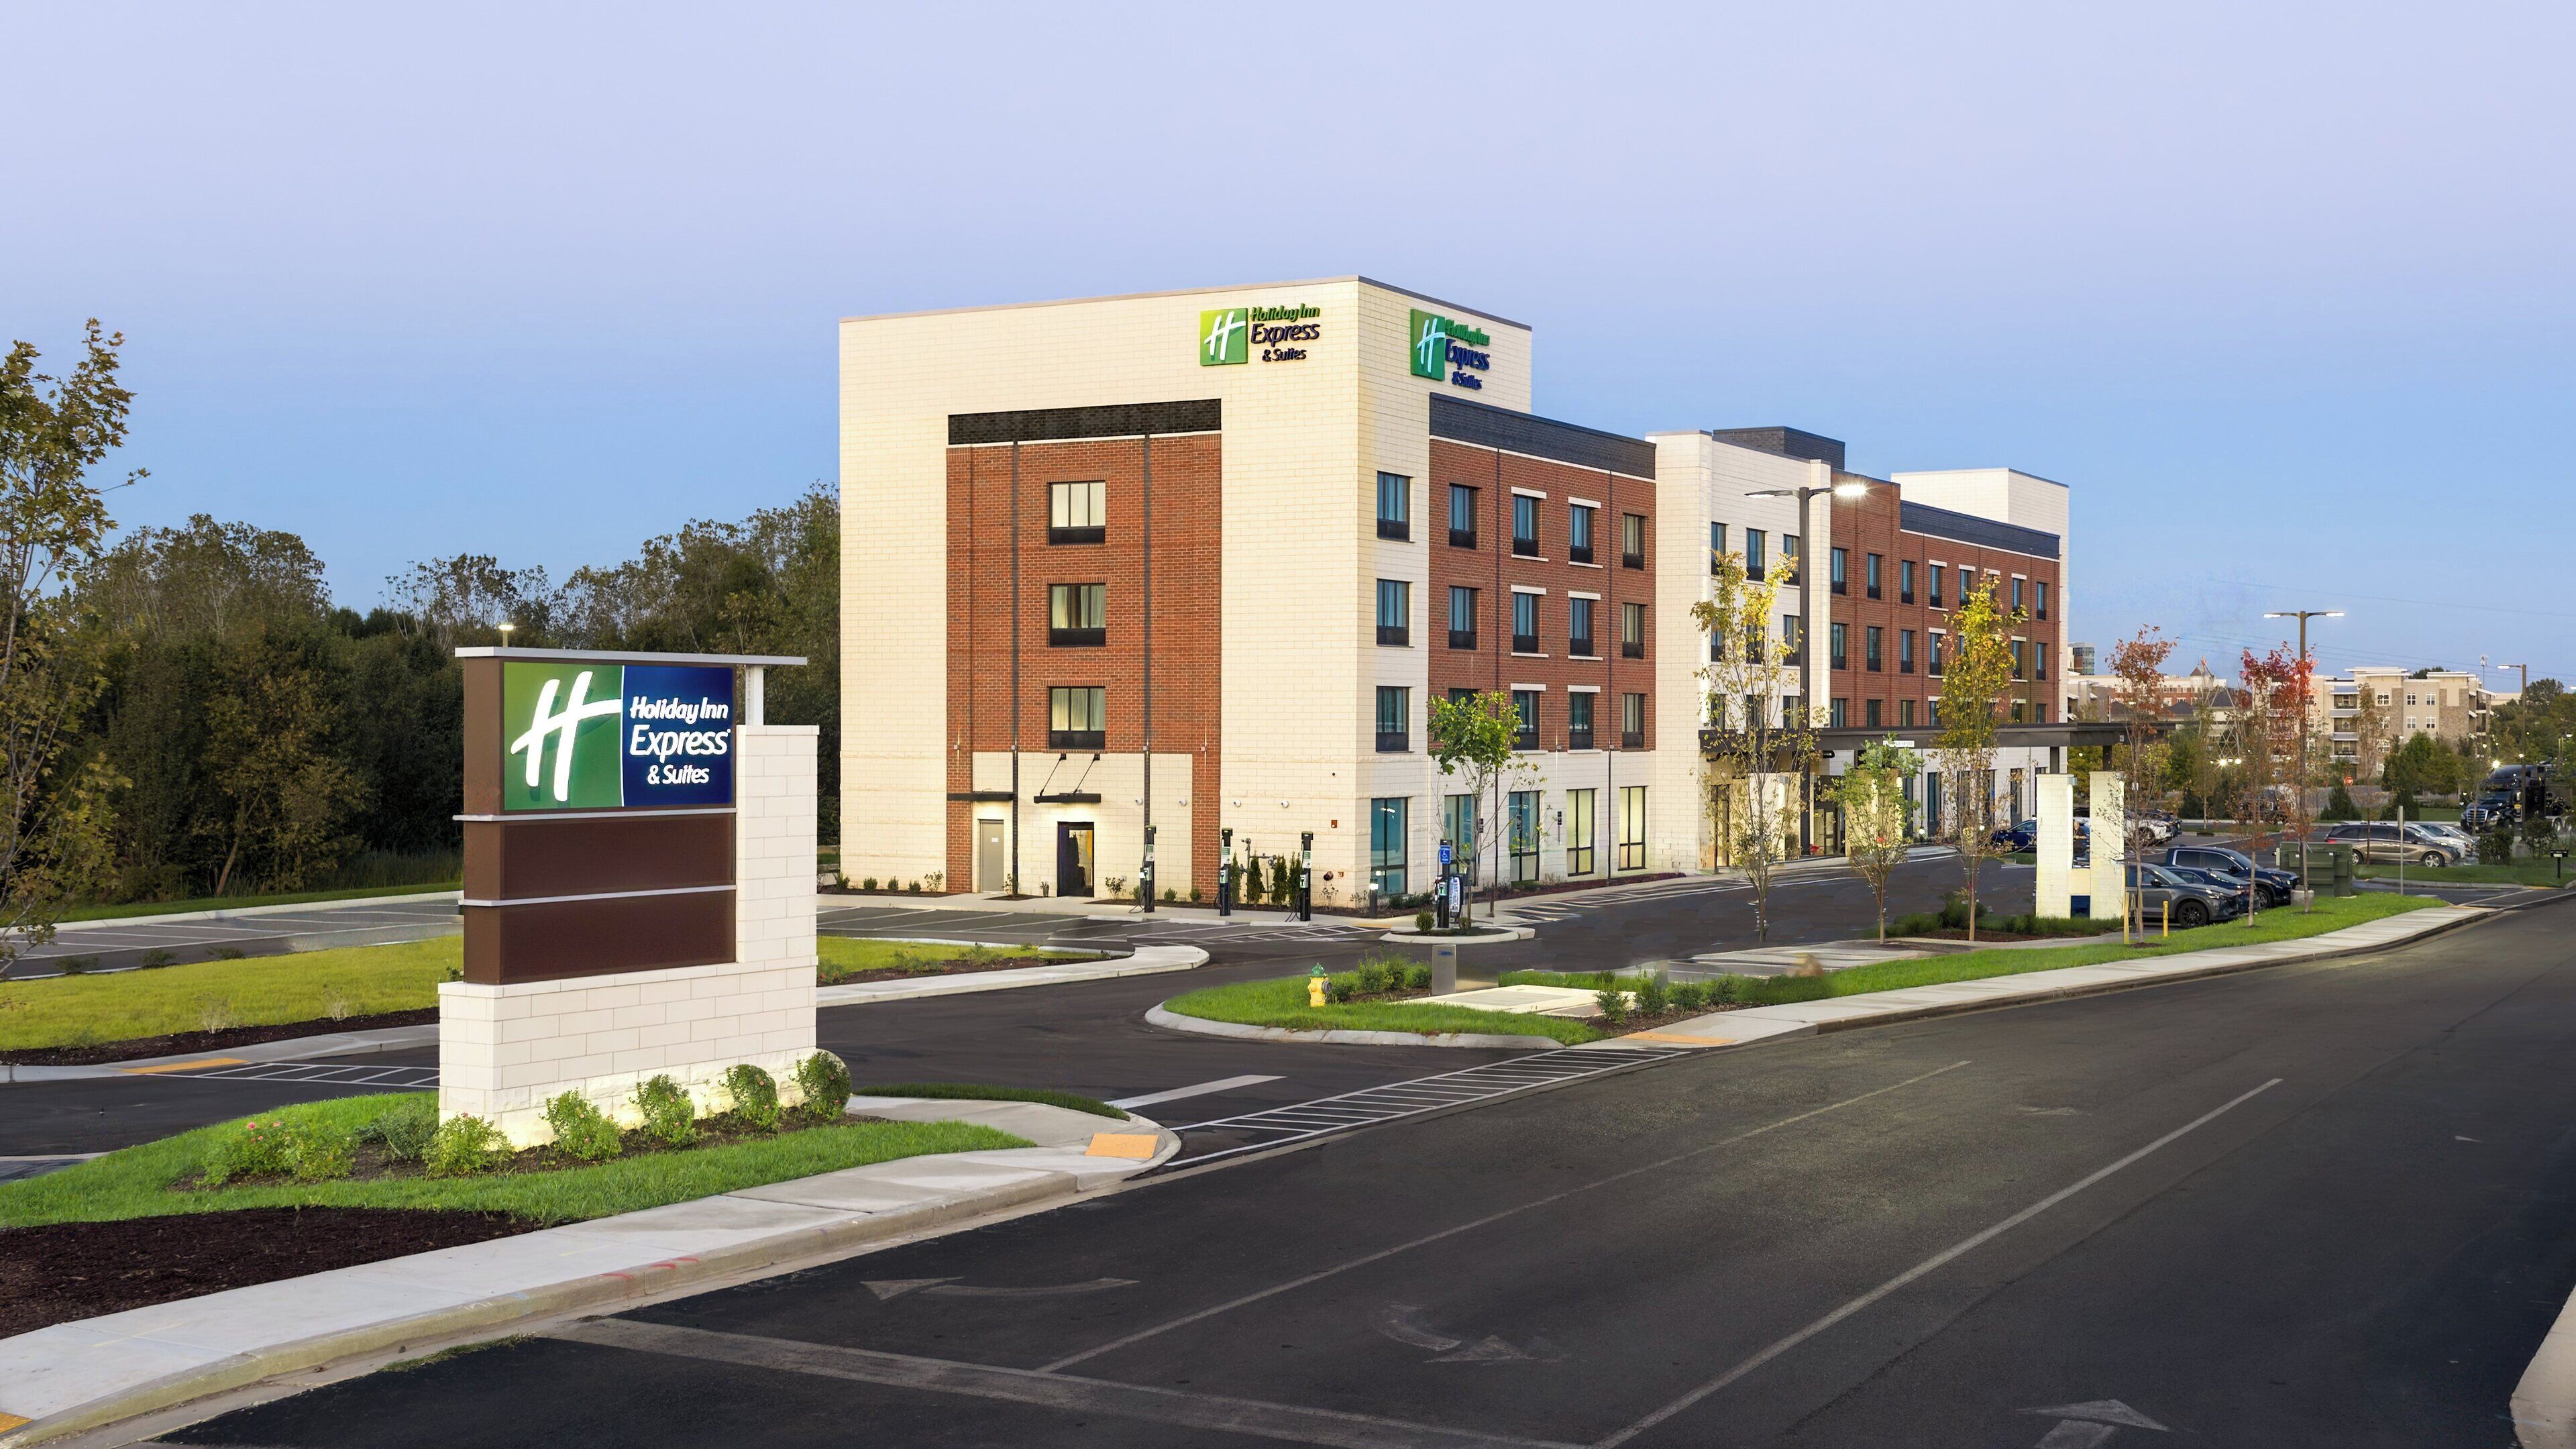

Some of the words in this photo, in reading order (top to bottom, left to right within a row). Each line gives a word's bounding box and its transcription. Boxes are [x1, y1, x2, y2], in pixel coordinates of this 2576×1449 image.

[1250, 305, 1299, 322] Holiday
[1299, 303, 1320, 319] Inn
[1250, 323, 1321, 347] Express
[1445, 319, 1477, 347] Holiday
[1475, 327, 1491, 346] Inn
[1262, 349, 1272, 362] &
[1272, 347, 1307, 362] Suites
[1444, 338, 1491, 370] Express
[1458, 372, 1483, 390] Suites
[630, 696, 699, 725] Holiday
[700, 696, 729, 720] Inn
[630, 724, 729, 763] Express
[647, 764, 660, 785] &
[662, 764, 710, 784] Suites
